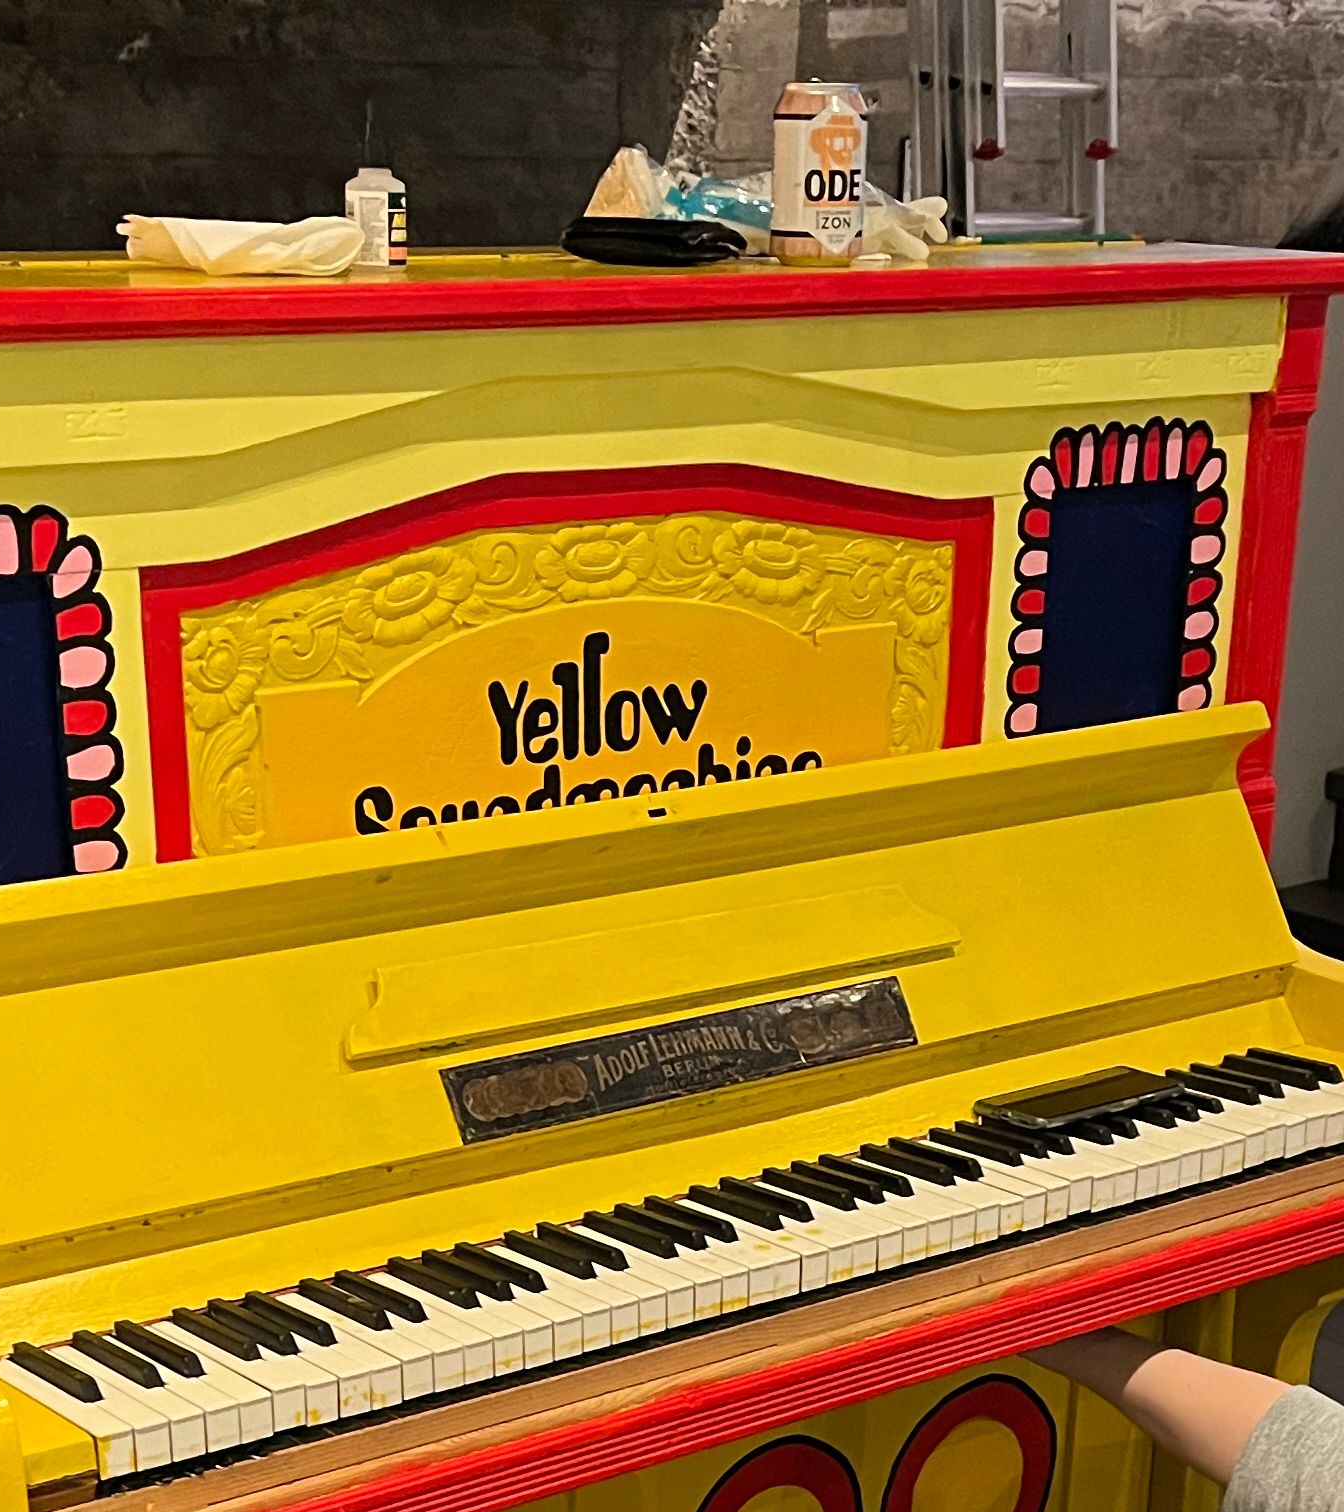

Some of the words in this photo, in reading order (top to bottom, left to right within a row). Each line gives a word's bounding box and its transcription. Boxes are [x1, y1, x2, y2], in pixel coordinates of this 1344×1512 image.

[804, 168, 861, 202] ODE
[821, 215, 851, 229] ZON
[487, 631, 708, 765] Yellow
[593, 1041, 650, 1092] ADOLF
[648, 1026, 746, 1062] LEHMANN
[746, 1029, 762, 1051] &
[661, 1055, 722, 1079] BERLIN
